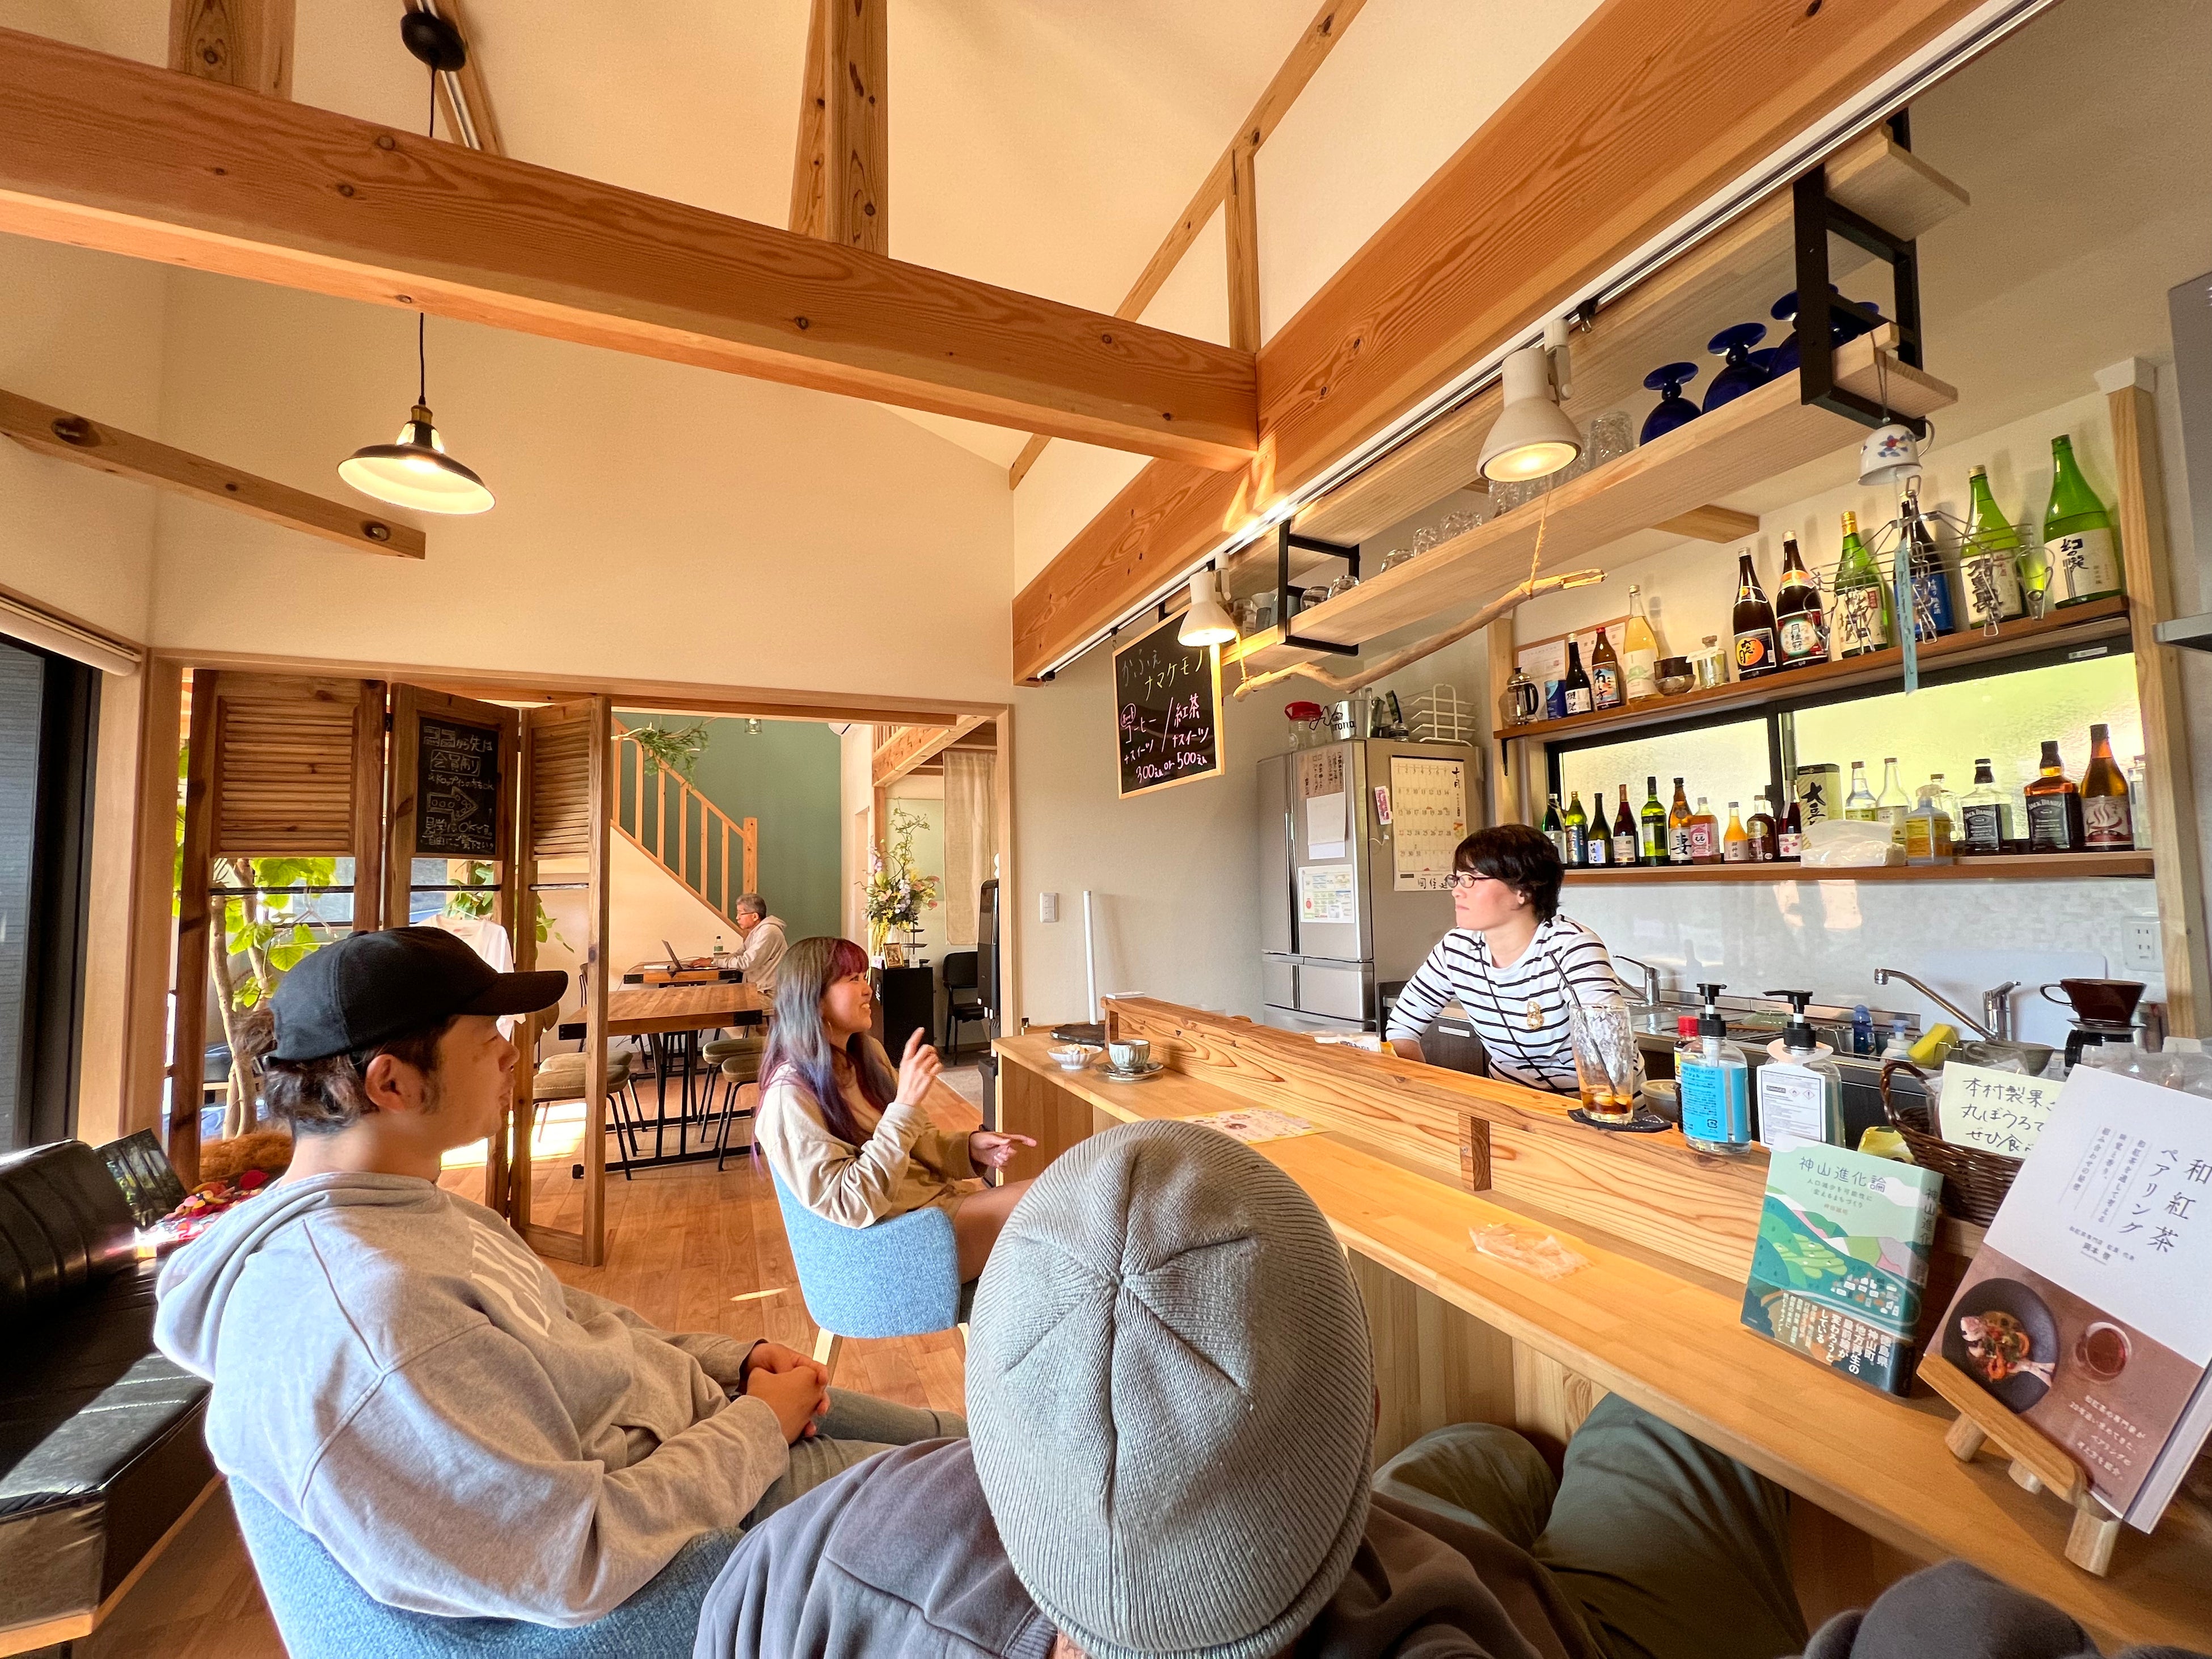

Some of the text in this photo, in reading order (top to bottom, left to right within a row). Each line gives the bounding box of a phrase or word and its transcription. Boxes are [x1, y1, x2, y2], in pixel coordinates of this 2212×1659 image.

[1145, 649, 1203, 702] ナマケモノ
[1174, 693, 1200, 728] 紅茶
[1125, 716, 1157, 744] コーヒー
[1164, 761, 1175, 770] or
[1671, 831, 1692, 855] 妻
[1799, 1156, 1887, 1193] 神山進化論
[2117, 1149, 2179, 1234] ペアリング
[2147, 1158, 2212, 1253] 和紅茶
[1816, 1309, 1829, 1344] している
[1825, 1313, 1842, 1362] 変わろうと
